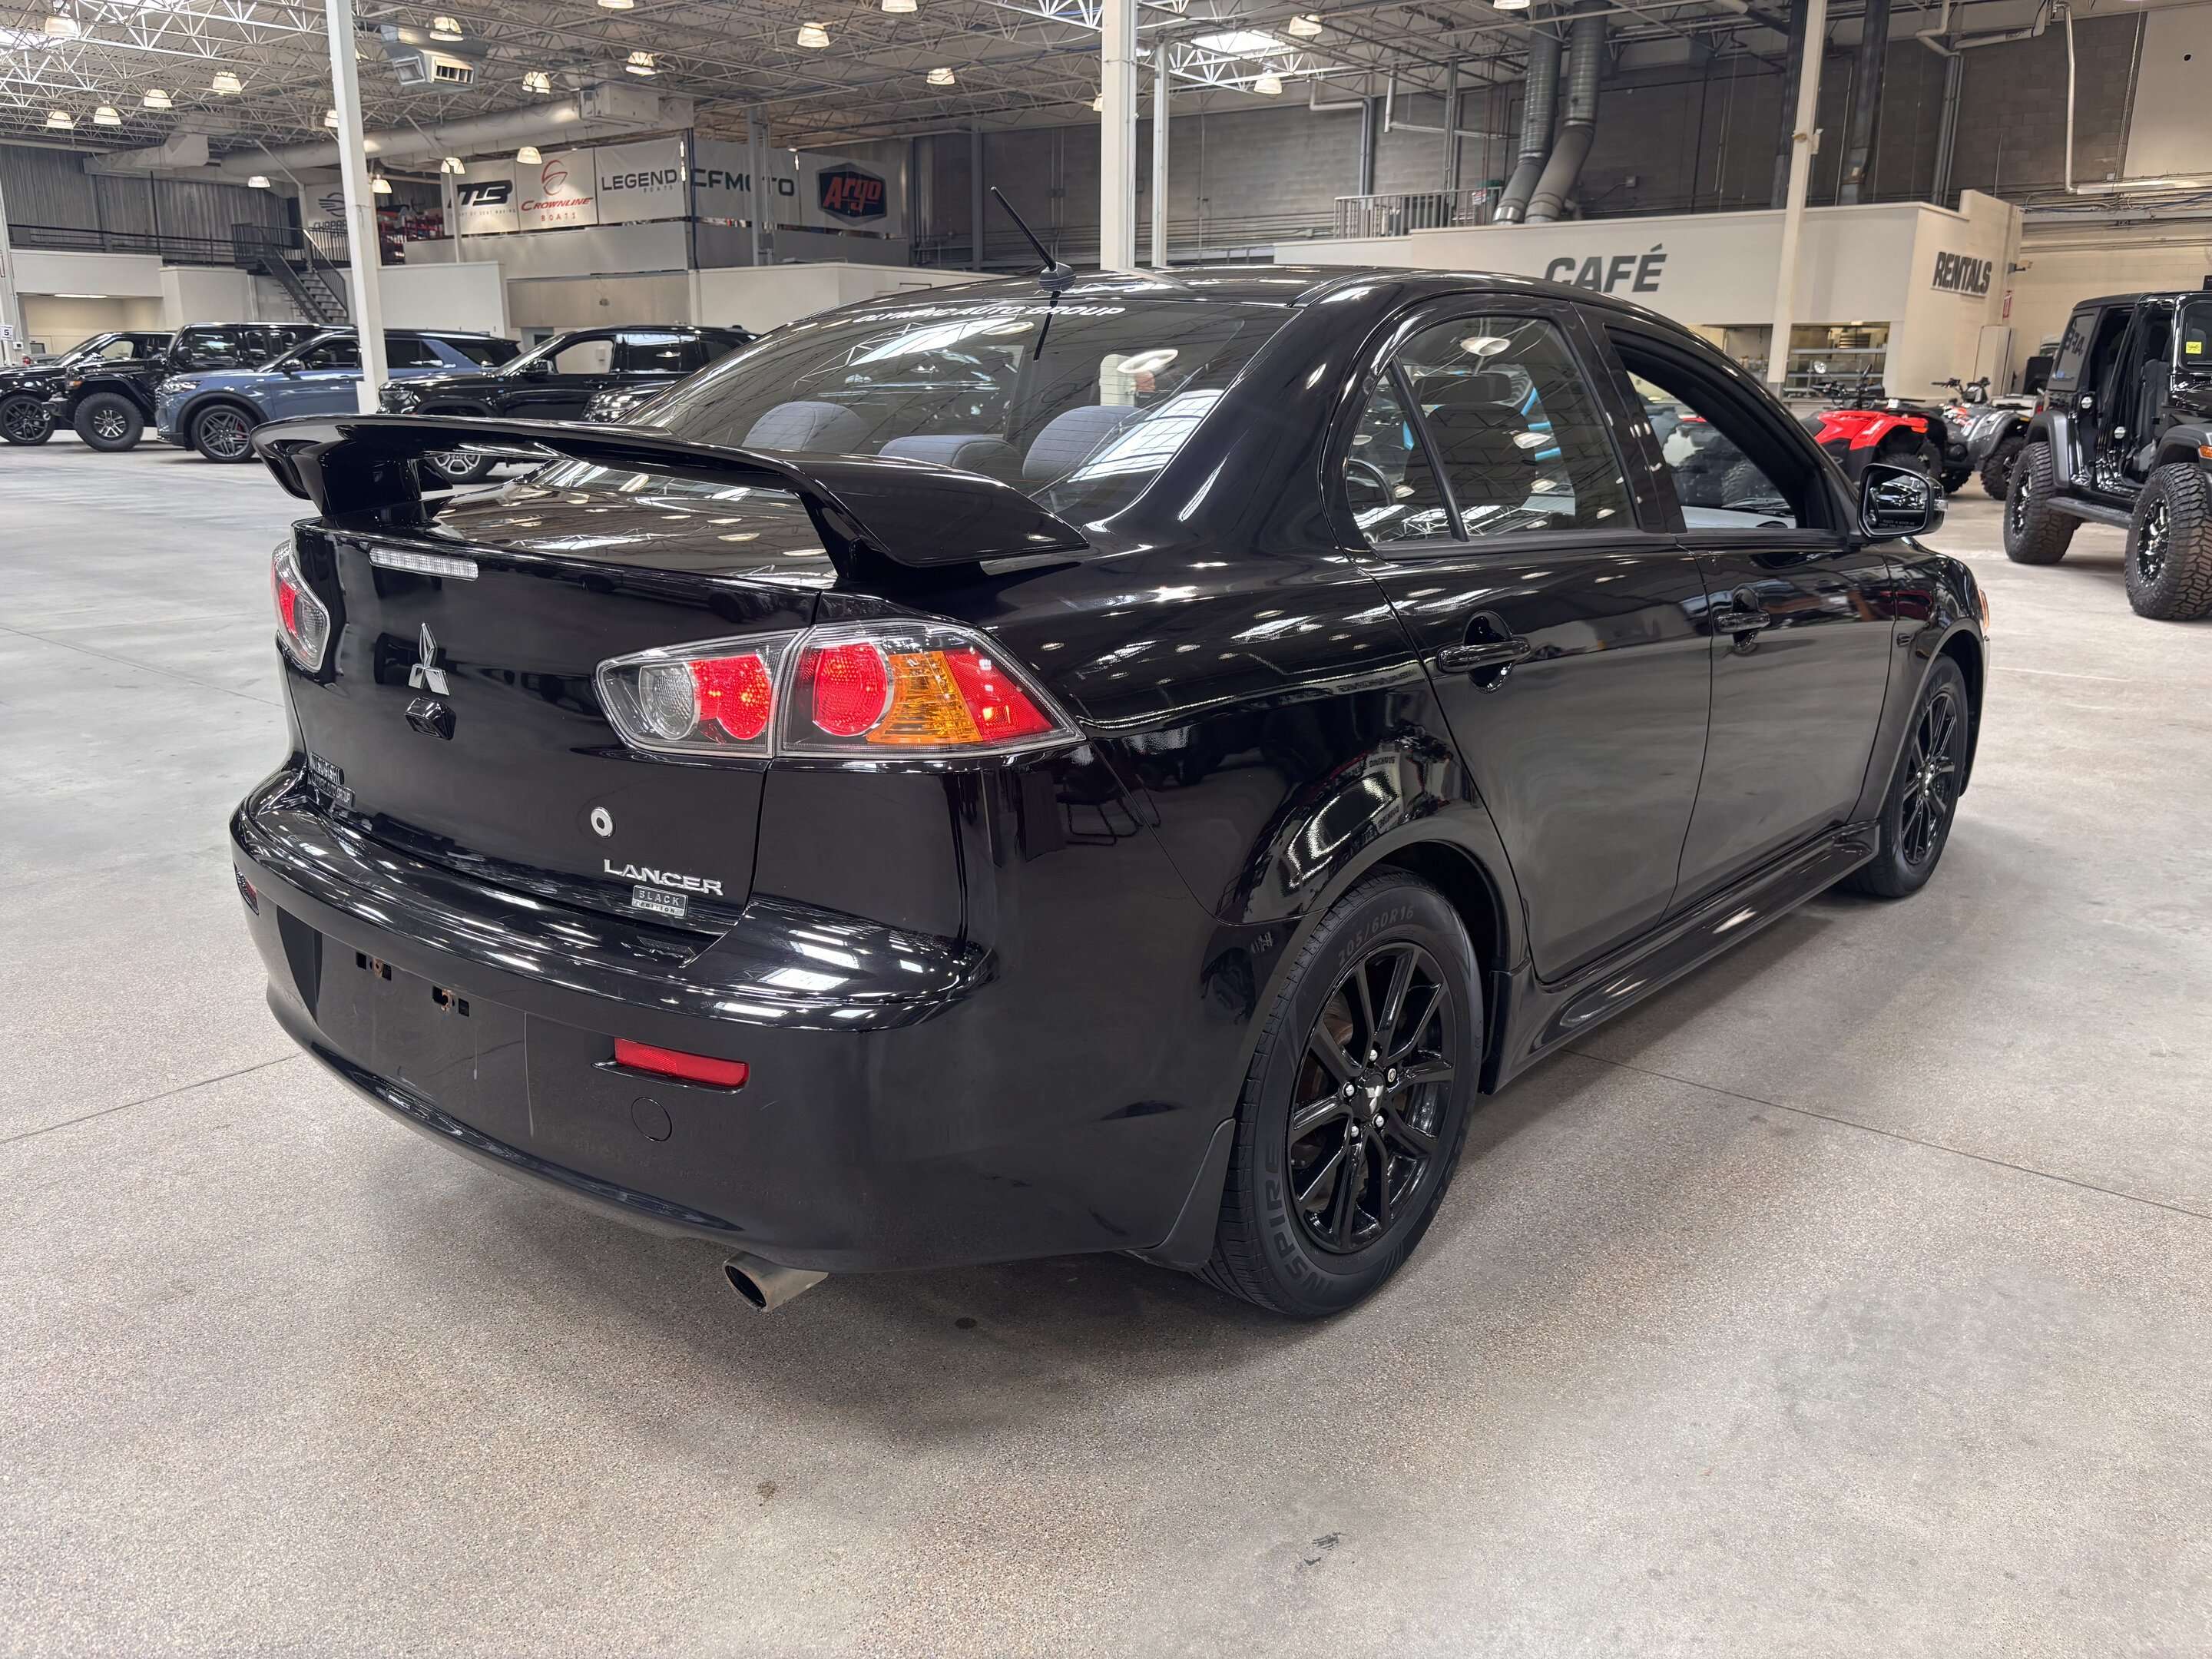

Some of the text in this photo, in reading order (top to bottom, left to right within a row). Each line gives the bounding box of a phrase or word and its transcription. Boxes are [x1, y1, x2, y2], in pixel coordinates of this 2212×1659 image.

[601, 169, 677, 191] LEGEND
[521, 197, 594, 212] CROWNLINE
[541, 213, 576, 222] BOATS
[1545, 243, 1667, 293] CAFÉ
[1932, 251, 1992, 294] RENTALS
[952, 306, 1028, 316] AUTO
[1025, 306, 1126, 316] GROUP
[604, 859, 724, 896] LANCER
[638, 889, 680, 906] BLACK
[1338, 905, 1414, 967] 205/60R16
